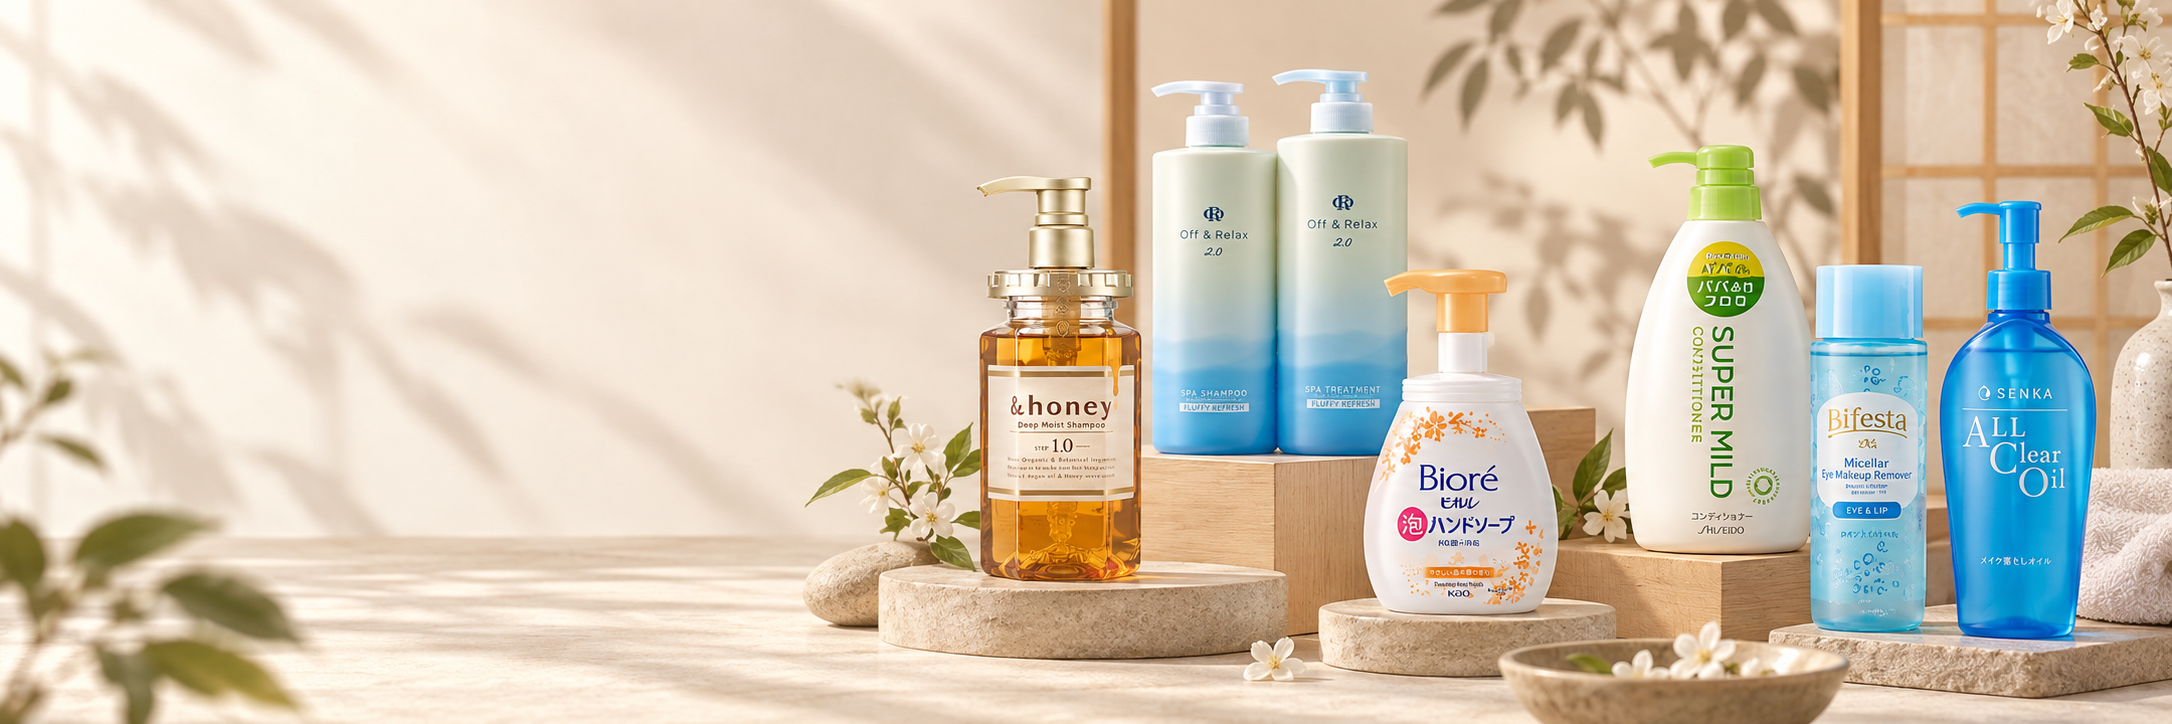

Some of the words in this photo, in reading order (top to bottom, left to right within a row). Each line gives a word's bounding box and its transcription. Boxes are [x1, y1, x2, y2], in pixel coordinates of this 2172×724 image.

[1307, 219, 1327, 229] Off
[1332, 219, 1341, 229] &
[1344, 219, 1378, 229] Relax
[1179, 229, 1199, 240] Off
[1203, 230, 1211, 240] &
[1215, 229, 1249, 240] Relax
[1332, 237, 1353, 247] 2.0
[1203, 246, 1223, 256] 2.0
[1711, 326, 1734, 421] SUPER
[1180, 389, 1197, 397] SPA
[1201, 389, 1248, 397] SHAMPOO
[1305, 385, 1321, 393] SPA
[1324, 385, 1381, 394] TREATMENT
[1997, 387, 2053, 400] SENKA
[1828, 406, 1907, 432] Bifesta
[1018, 421, 1039, 430] Deep
[1041, 421, 1065, 429] Moist
[1066, 421, 1106, 430] Shampoo
[1962, 415, 2026, 448] ALL
[1052, 438, 1074, 453] 1.0
[1844, 457, 1889, 468] Micellar
[1990, 441, 2062, 474] Clear
[1710, 431, 1733, 498] MILD
[1419, 464, 1499, 491] Bioré
[1821, 469, 1834, 480] Eye
[1835, 470, 1872, 481] Makeup
[1874, 470, 1912, 480] Remover
[2018, 466, 2065, 498] Oil
[1846, 506, 1863, 515] EYE
[1865, 507, 1871, 515] &
[1873, 506, 1888, 515] LIP
[1697, 525, 1745, 535] SHISEIDO
